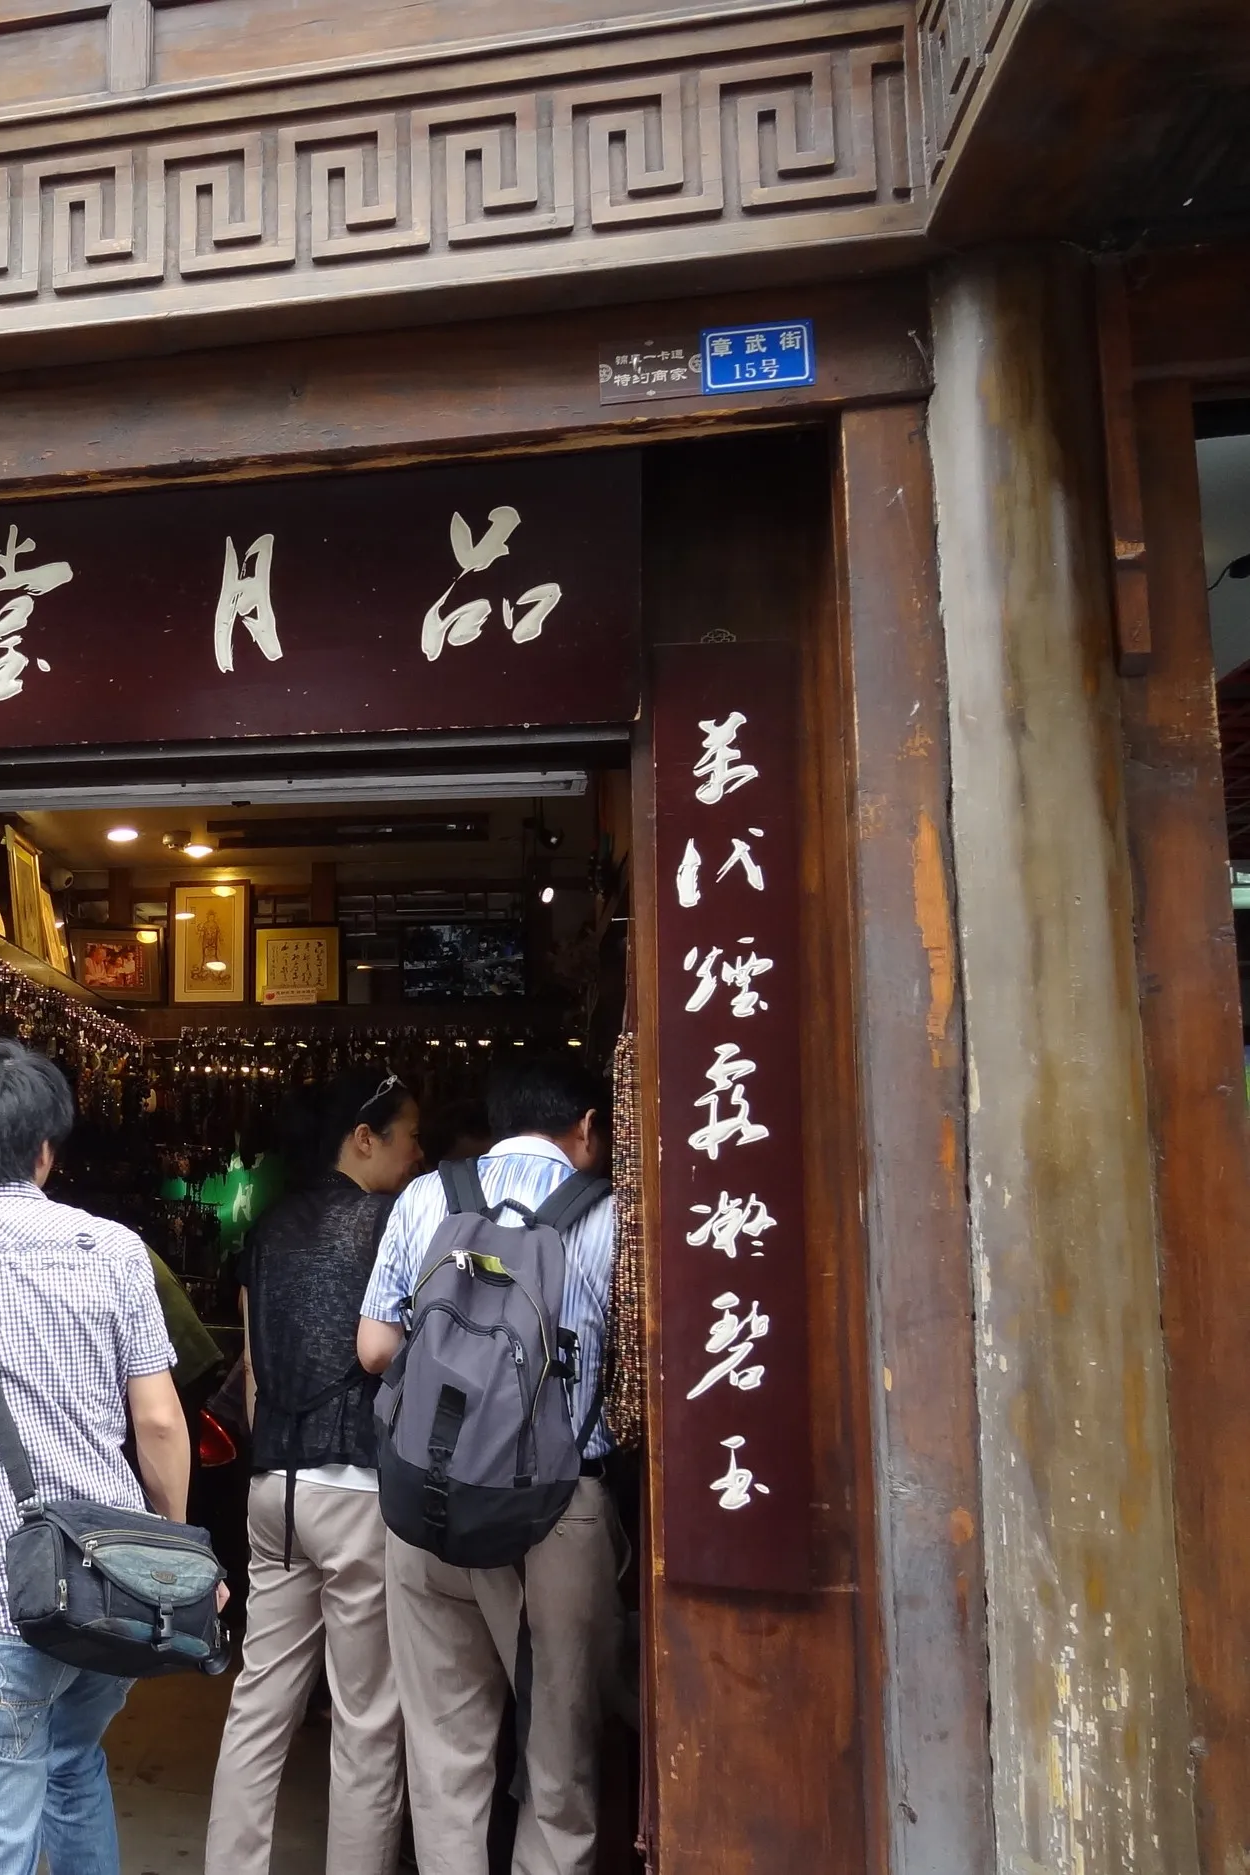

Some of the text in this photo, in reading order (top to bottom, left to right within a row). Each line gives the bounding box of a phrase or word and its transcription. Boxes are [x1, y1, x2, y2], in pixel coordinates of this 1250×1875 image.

[710, 331, 802, 357] 章武街
[613, 368, 688, 387] 特约商家
[733, 358, 780, 380] 15号
